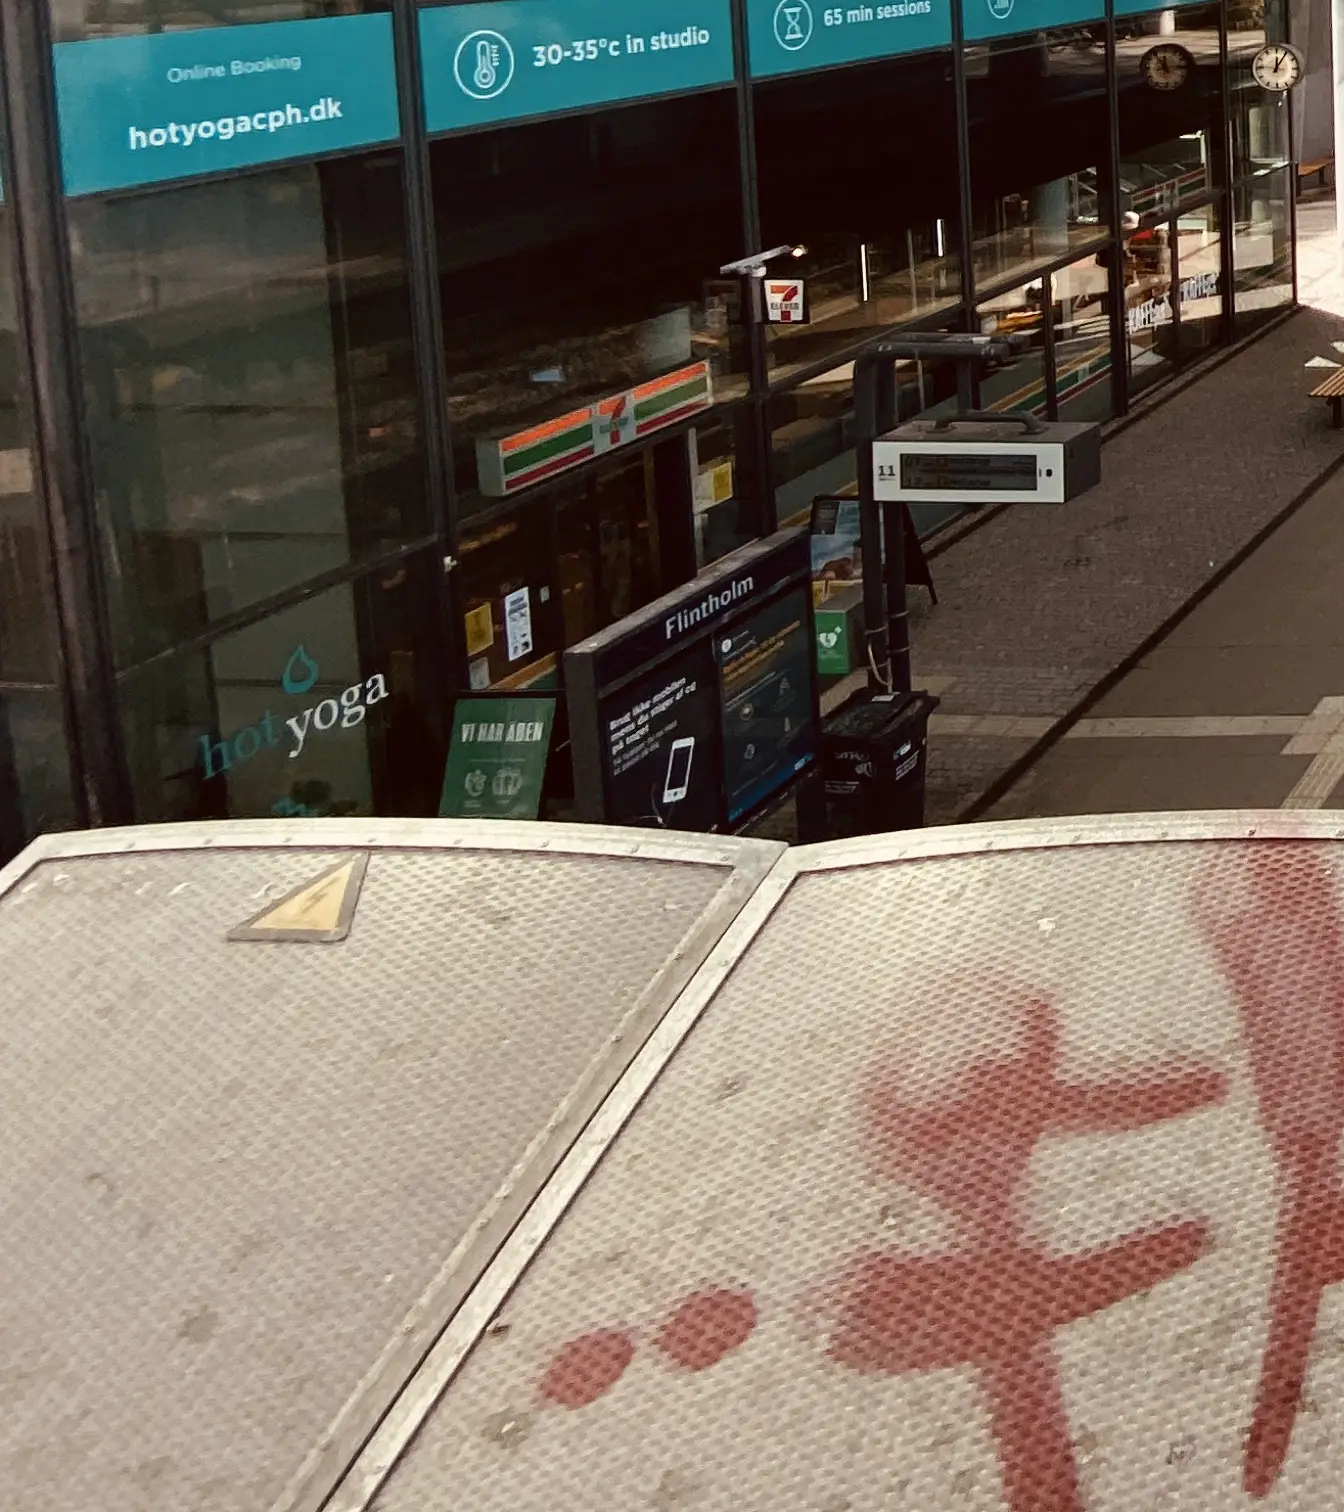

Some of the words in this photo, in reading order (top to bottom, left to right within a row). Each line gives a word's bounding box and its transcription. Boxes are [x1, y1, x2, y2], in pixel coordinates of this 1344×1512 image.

[823, 7, 843, 27] 65
[846, 4, 874, 24] min
[625, 34, 645, 54] in
[650, 26, 710, 51] studio
[166, 64, 226, 84] Online
[230, 56, 302, 76] Booking
[128, 96, 344, 150] hotyogacph.dk
[877, 465, 896, 477] 11
[665, 576, 754, 639] Flintholm
[198, 709, 280, 780] hot
[285, 673, 390, 759] yoga
[461, 723, 476, 744] VI
[476, 722, 504, 744] HAR
